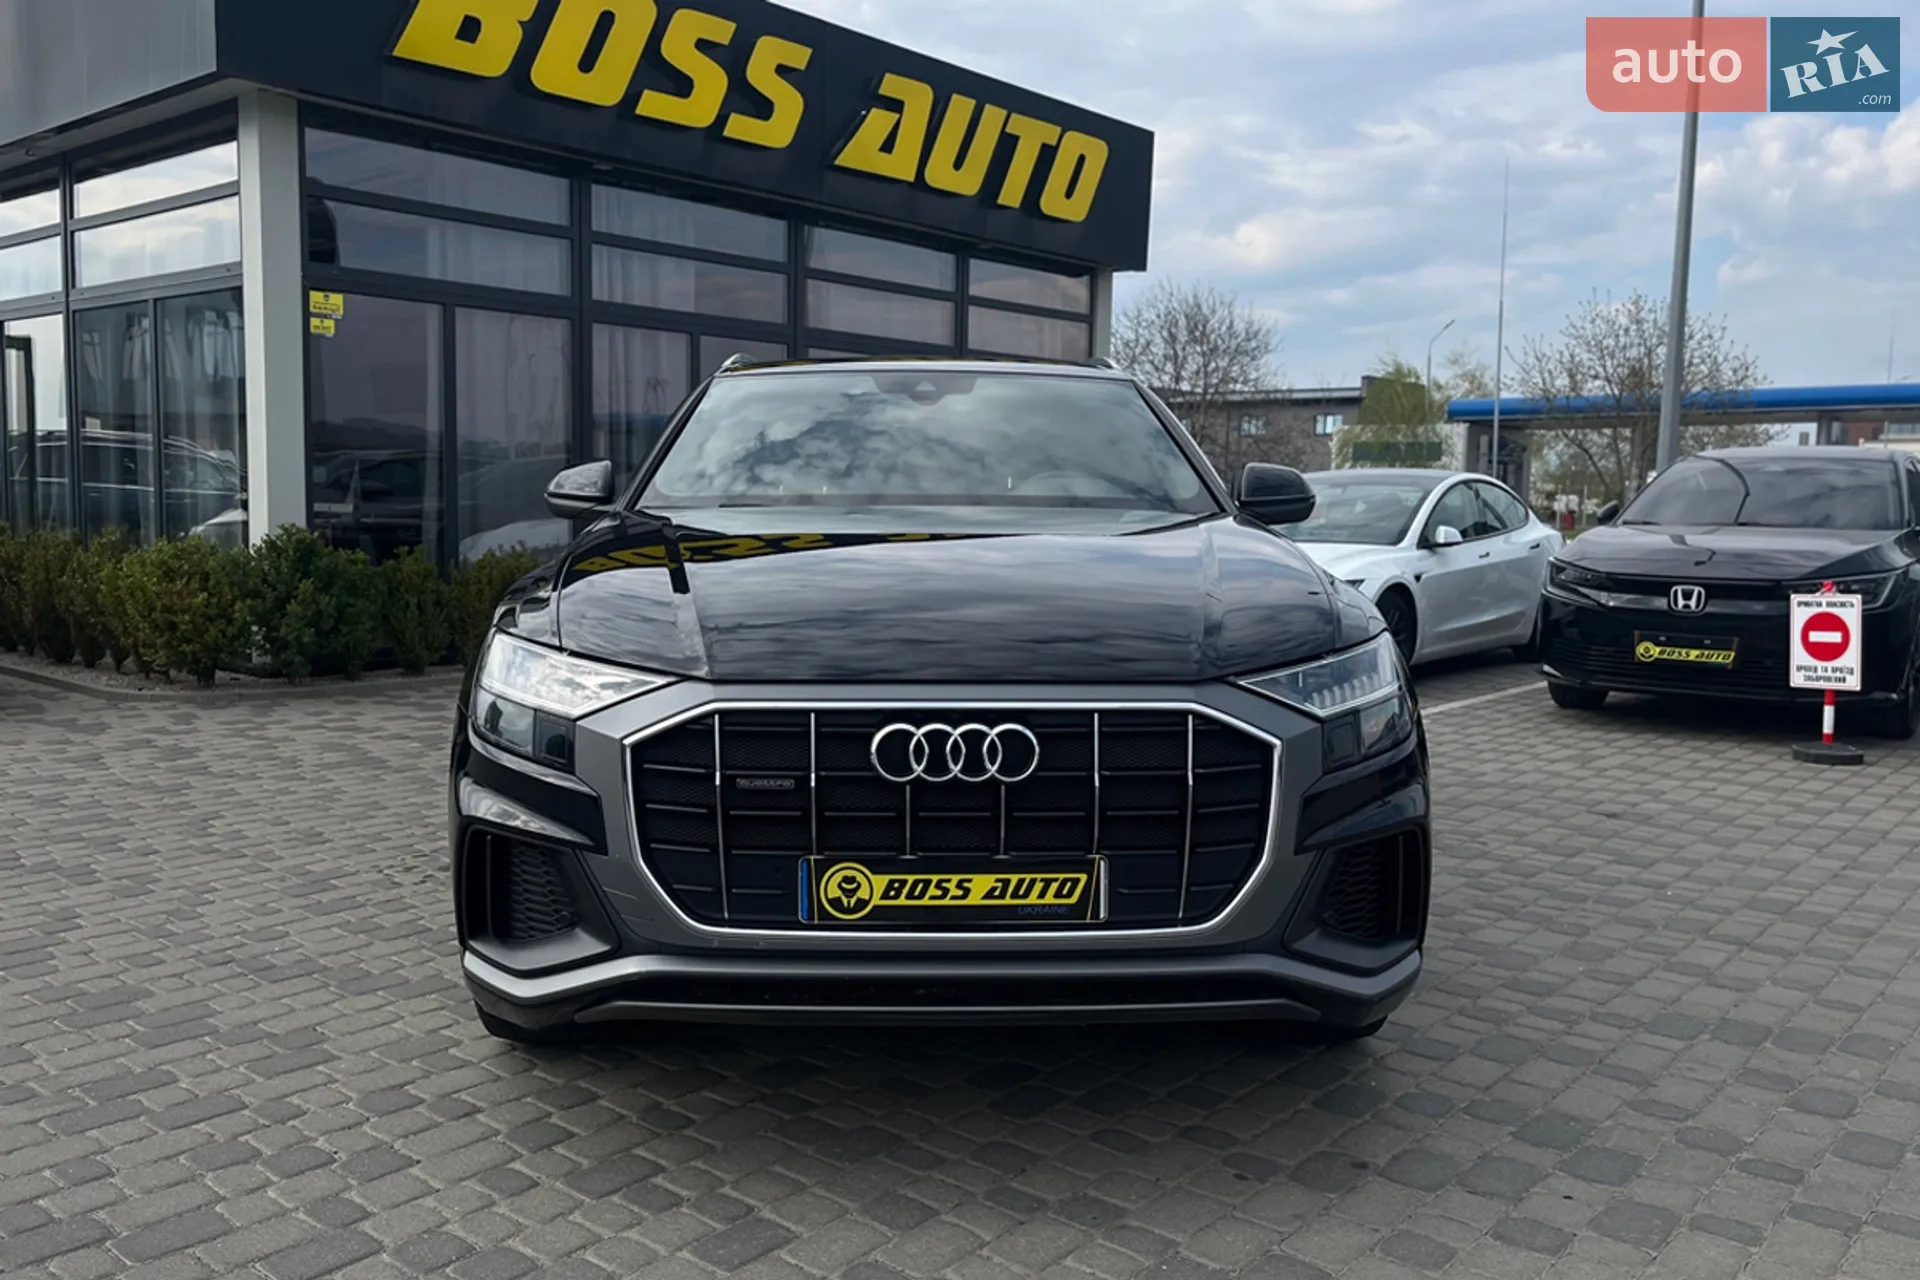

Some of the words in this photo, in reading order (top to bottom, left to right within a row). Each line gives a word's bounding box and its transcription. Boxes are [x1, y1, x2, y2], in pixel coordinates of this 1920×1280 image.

[392, 0, 813, 149] BOSS
[834, 72, 1109, 223] AUTO
[1658, 649, 1691, 659] BOSS
[1695, 651, 1731, 661] AUTO
[879, 878, 974, 900] BOSS
[981, 877, 1081, 900] AUTO
[1018, 905, 1070, 914] UKRAINE
